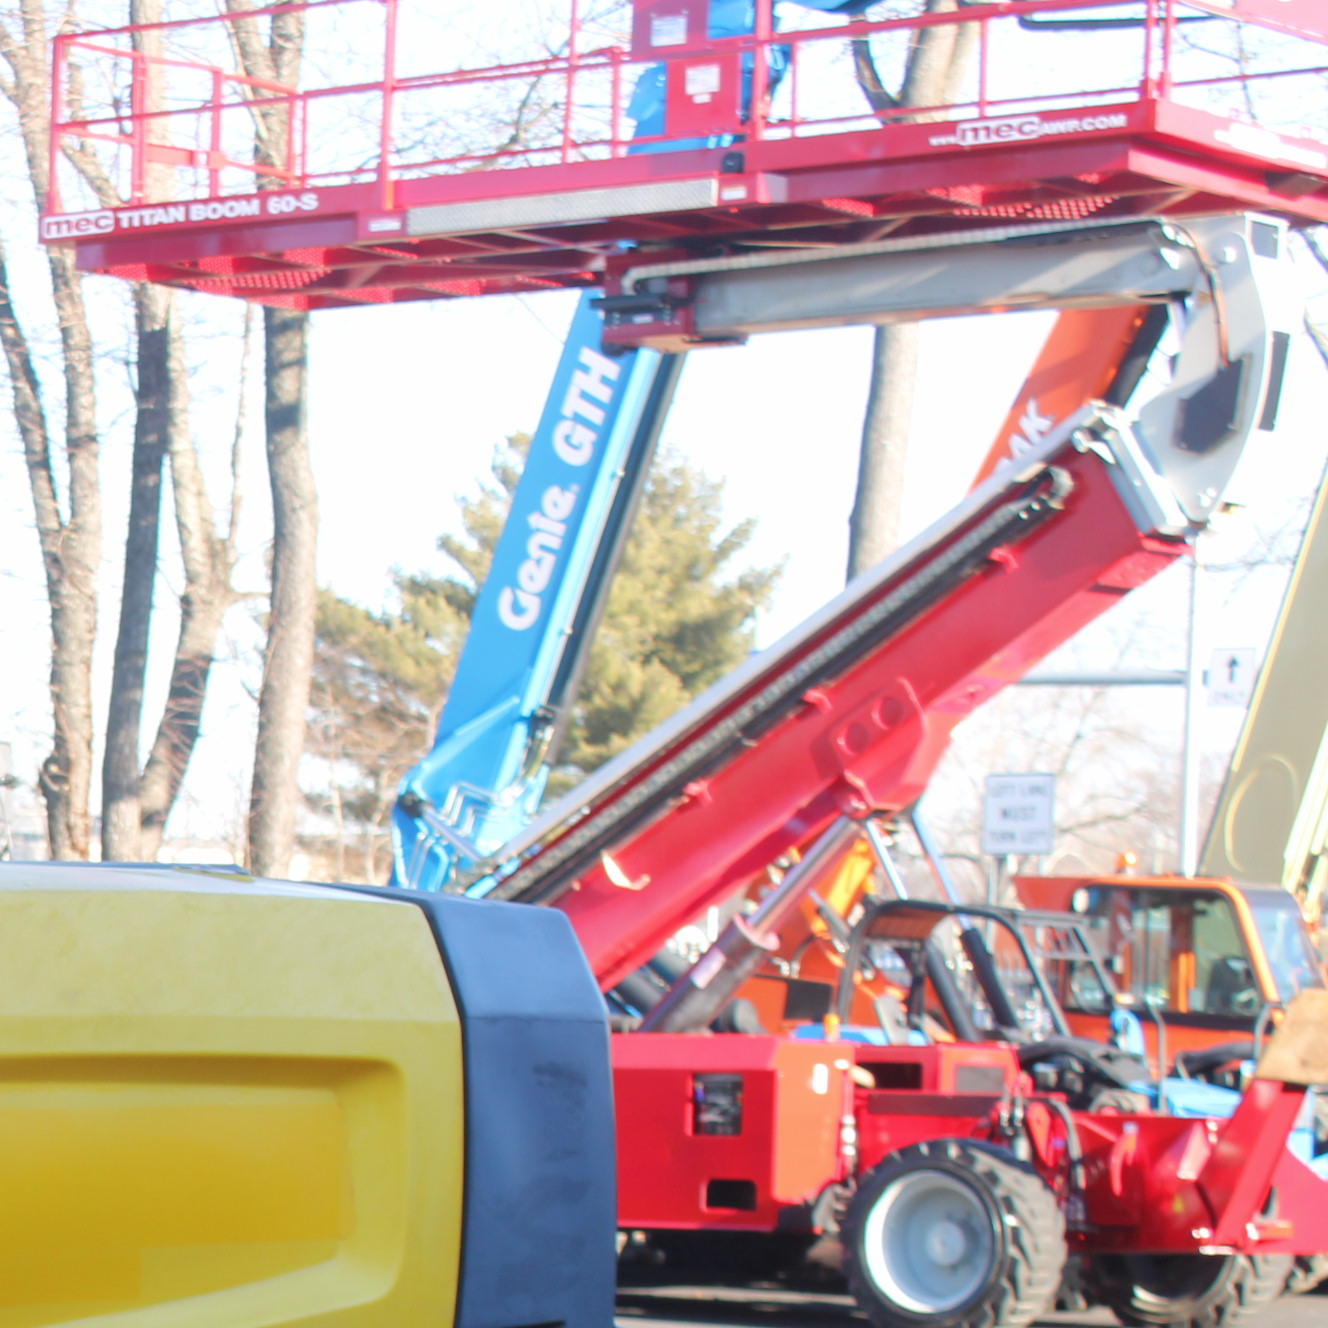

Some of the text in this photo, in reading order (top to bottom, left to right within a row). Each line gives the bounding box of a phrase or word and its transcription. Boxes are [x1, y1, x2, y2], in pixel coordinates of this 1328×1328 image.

[45, 193, 319, 239] mec TITAN BOOM 60-S
[498, 346, 622, 631] Genie GTH
